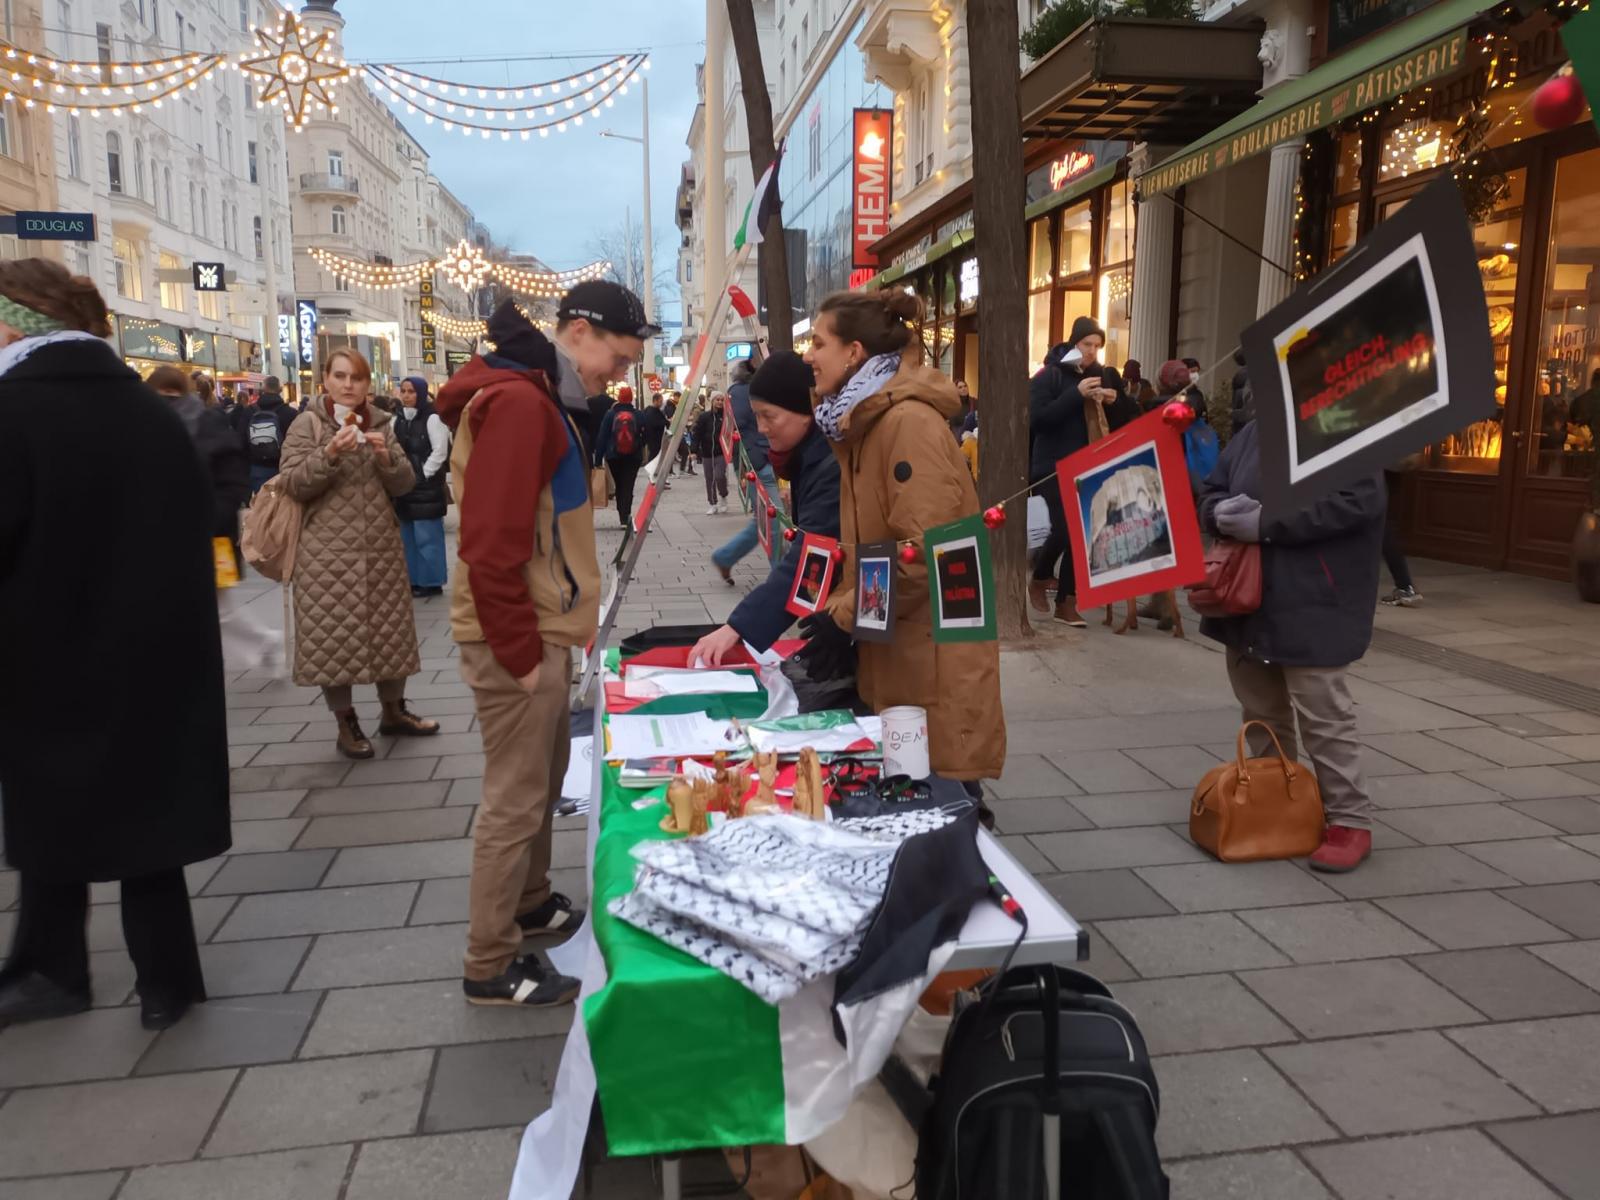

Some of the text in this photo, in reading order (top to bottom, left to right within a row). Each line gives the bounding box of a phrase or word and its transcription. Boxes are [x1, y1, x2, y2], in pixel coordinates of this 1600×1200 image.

[1143, 152, 1209, 196] VIENNOISERIE
[1231, 101, 1321, 161] BOULANGERIE
[1355, 37, 1461, 107] PÂTISSERIE
[26, 219, 85, 233] DOUGLAS
[858, 136, 885, 241] HEMA
[299, 302, 317, 363] orsay
